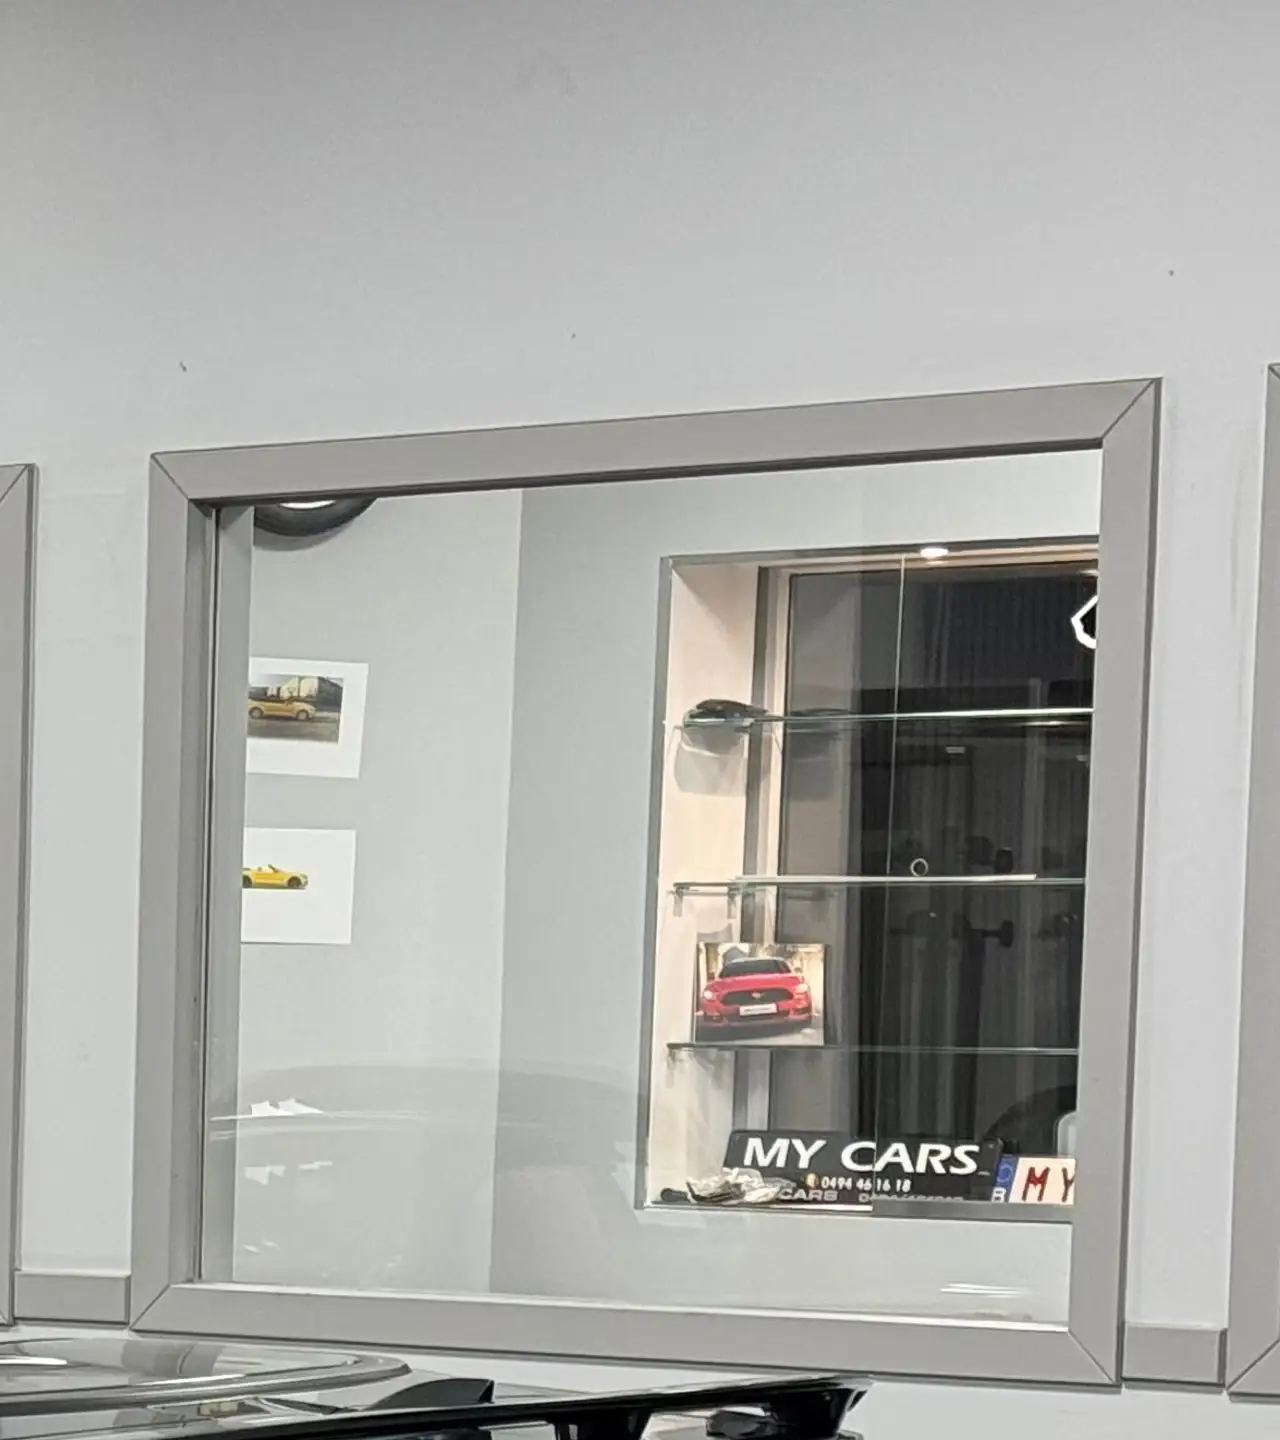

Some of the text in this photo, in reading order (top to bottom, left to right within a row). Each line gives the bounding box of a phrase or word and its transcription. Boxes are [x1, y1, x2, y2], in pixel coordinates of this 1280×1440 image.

[743, 1137, 980, 1176] MY CARS
[821, 1175, 912, 1193] 0494 46 16 18
